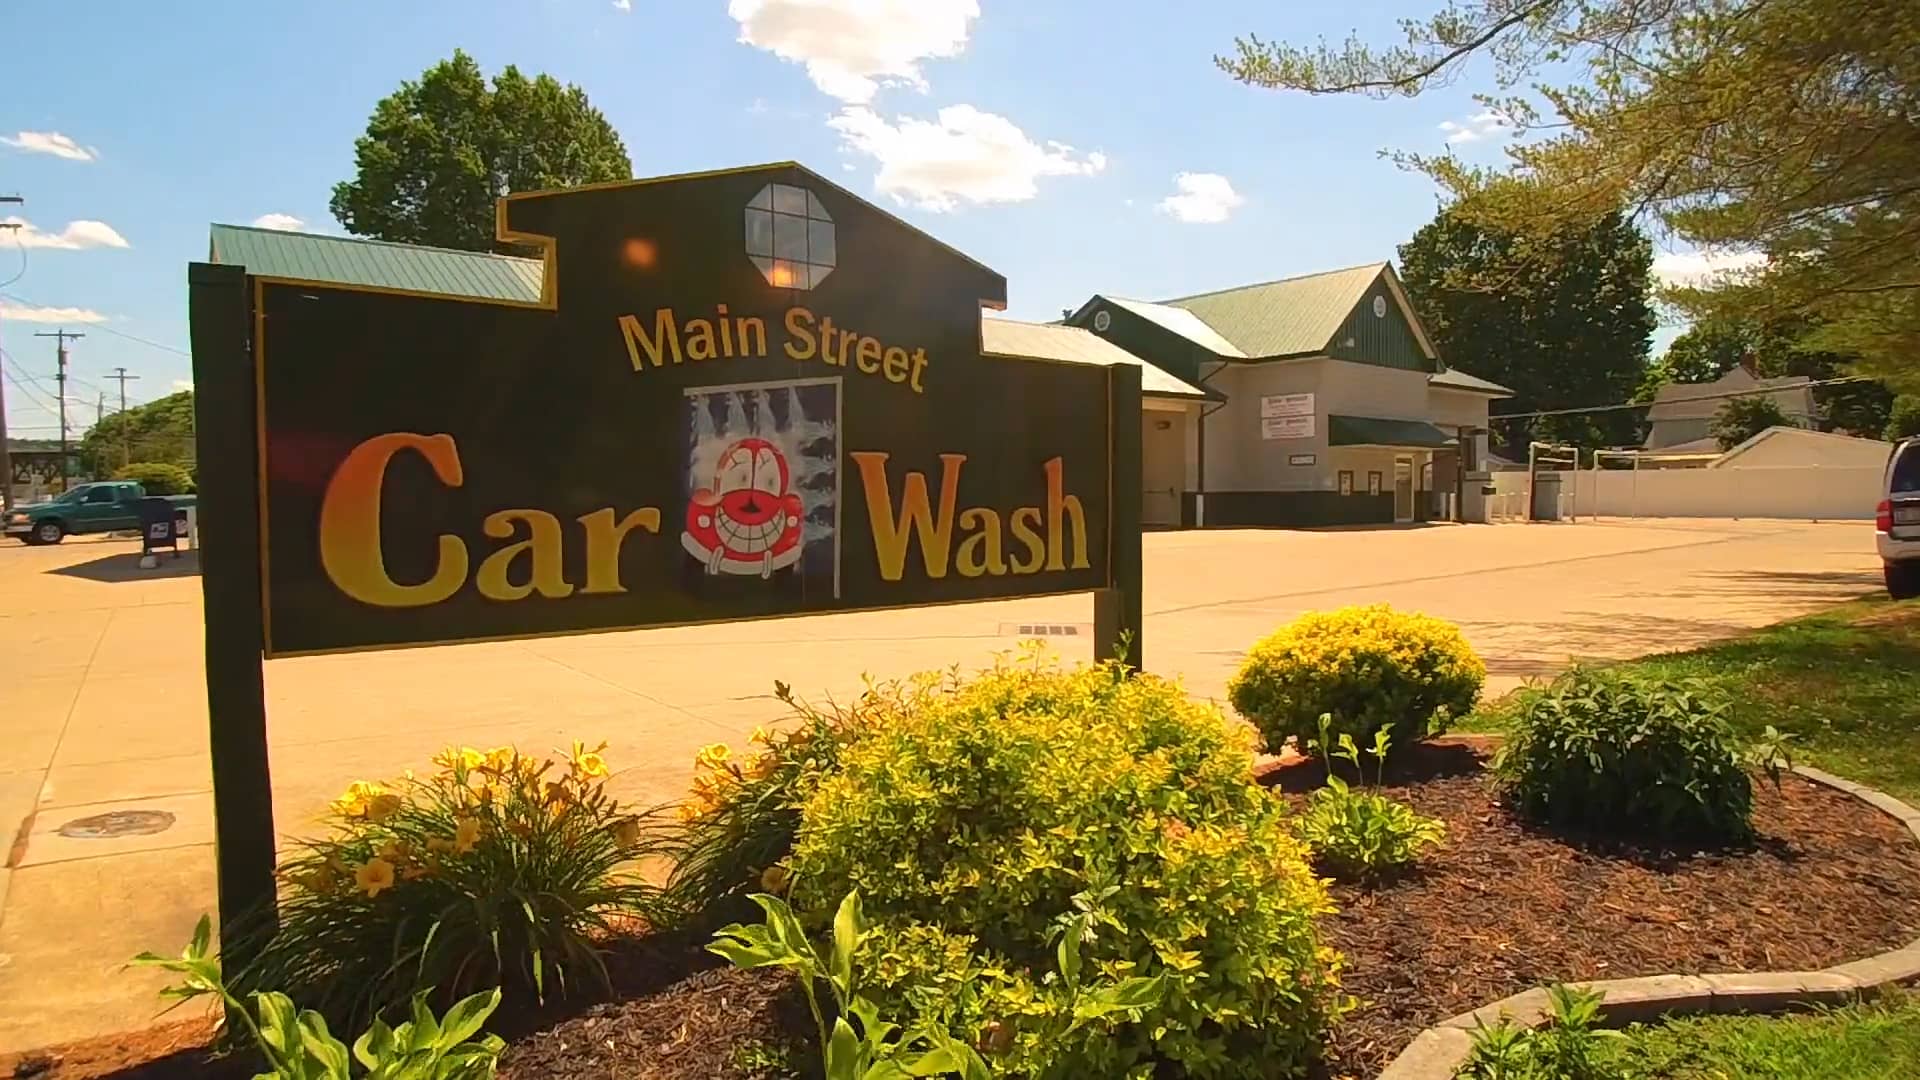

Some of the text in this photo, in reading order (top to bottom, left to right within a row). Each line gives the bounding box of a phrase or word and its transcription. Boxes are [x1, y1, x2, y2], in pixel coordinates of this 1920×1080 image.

[618, 303, 929, 394] Main Street
[320, 432, 1091, 607] Car Wash
